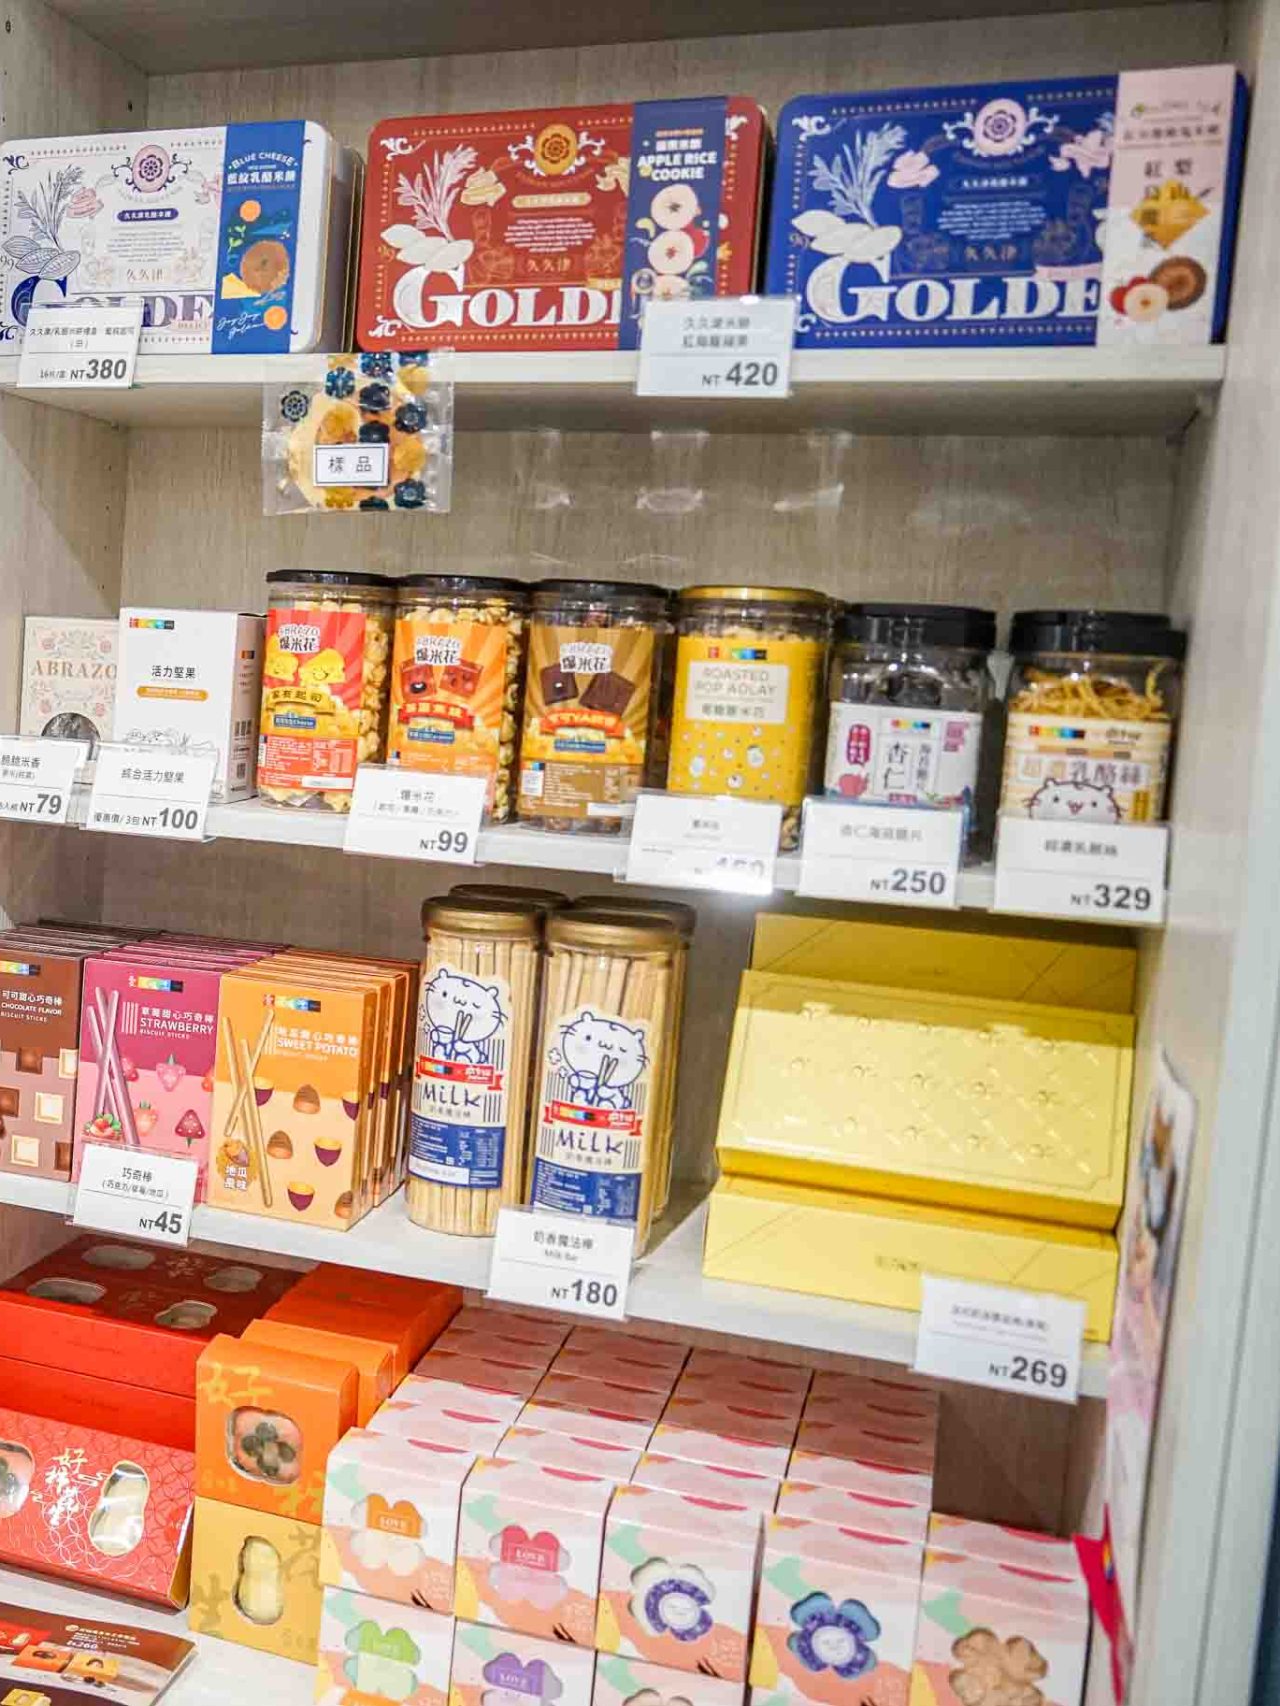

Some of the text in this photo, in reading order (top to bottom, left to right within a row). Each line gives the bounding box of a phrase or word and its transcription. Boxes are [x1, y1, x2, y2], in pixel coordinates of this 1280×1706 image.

[231, 151, 296, 169] BLUE CHEESE
[637, 150, 718, 168] APPLE RICE
[651, 166, 705, 181] COOKIE
[70, 358, 127, 380] NT 380
[701, 360, 779, 387] NT 420
[703, 666, 770, 683] ROASTED
[19, 793, 62, 815] NT 79
[141, 807, 199, 831] NT 100
[419, 829, 469, 853] NT 99
[870, 867, 947, 895] NT 250
[1070, 882, 1152, 912] NT 329
[1, 1002, 62, 1016] CHOCOLATE FLAVOR
[140, 1017, 214, 1035] STRAWBERRY
[276, 1038, 358, 1057] SWEET POTATO
[122, 1167, 153, 1183] 巧奇棒
[139, 1211, 183, 1234] NT 45
[550, 1278, 618, 1307] NT 180
[989, 1356, 1068, 1388] NT 269
[379, 1515, 409, 1530] LOVE
[515, 1549, 546, 1564] LOVE
